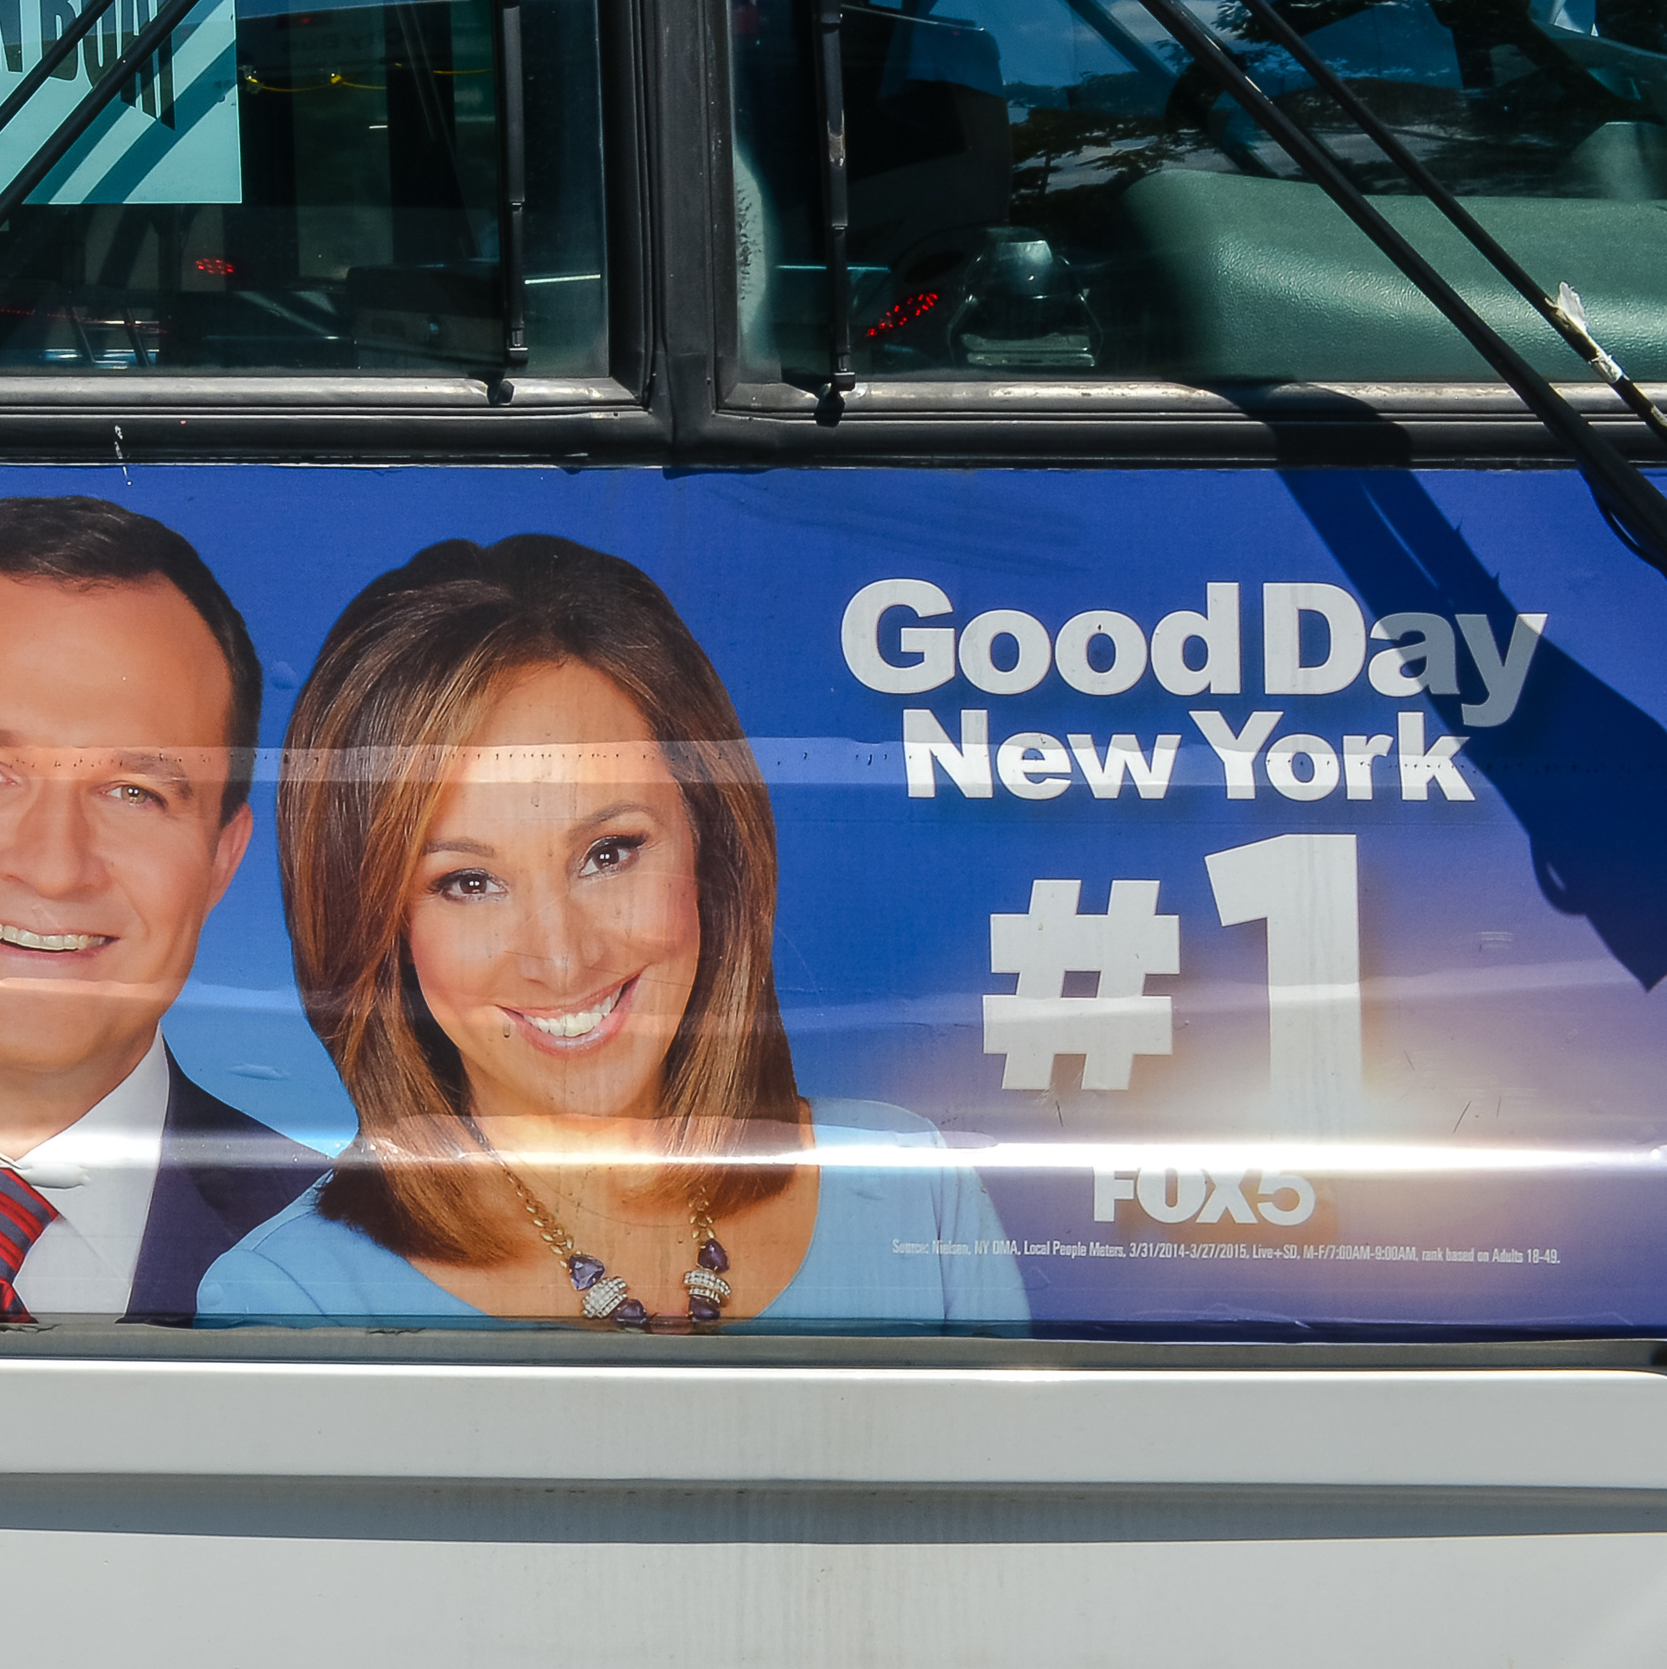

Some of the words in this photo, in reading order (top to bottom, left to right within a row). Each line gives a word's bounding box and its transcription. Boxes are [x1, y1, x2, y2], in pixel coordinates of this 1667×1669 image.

[903, 709, 1182, 800] New
[1189, 710, 1476, 802] York
[982, 834, 1364, 1144] #1
[892, 1239, 929, 1254] Source:
[975, 1240, 989, 1254] NY
[1024, 1240, 1050, 1255] Local
[1053, 1240, 1086, 1258] People
[1422, 1247, 1443, 1261] rank
[1446, 1247, 1474, 1262] based
[1477, 1251, 1489, 1262] on
[1492, 1248, 1523, 1263] Adults
